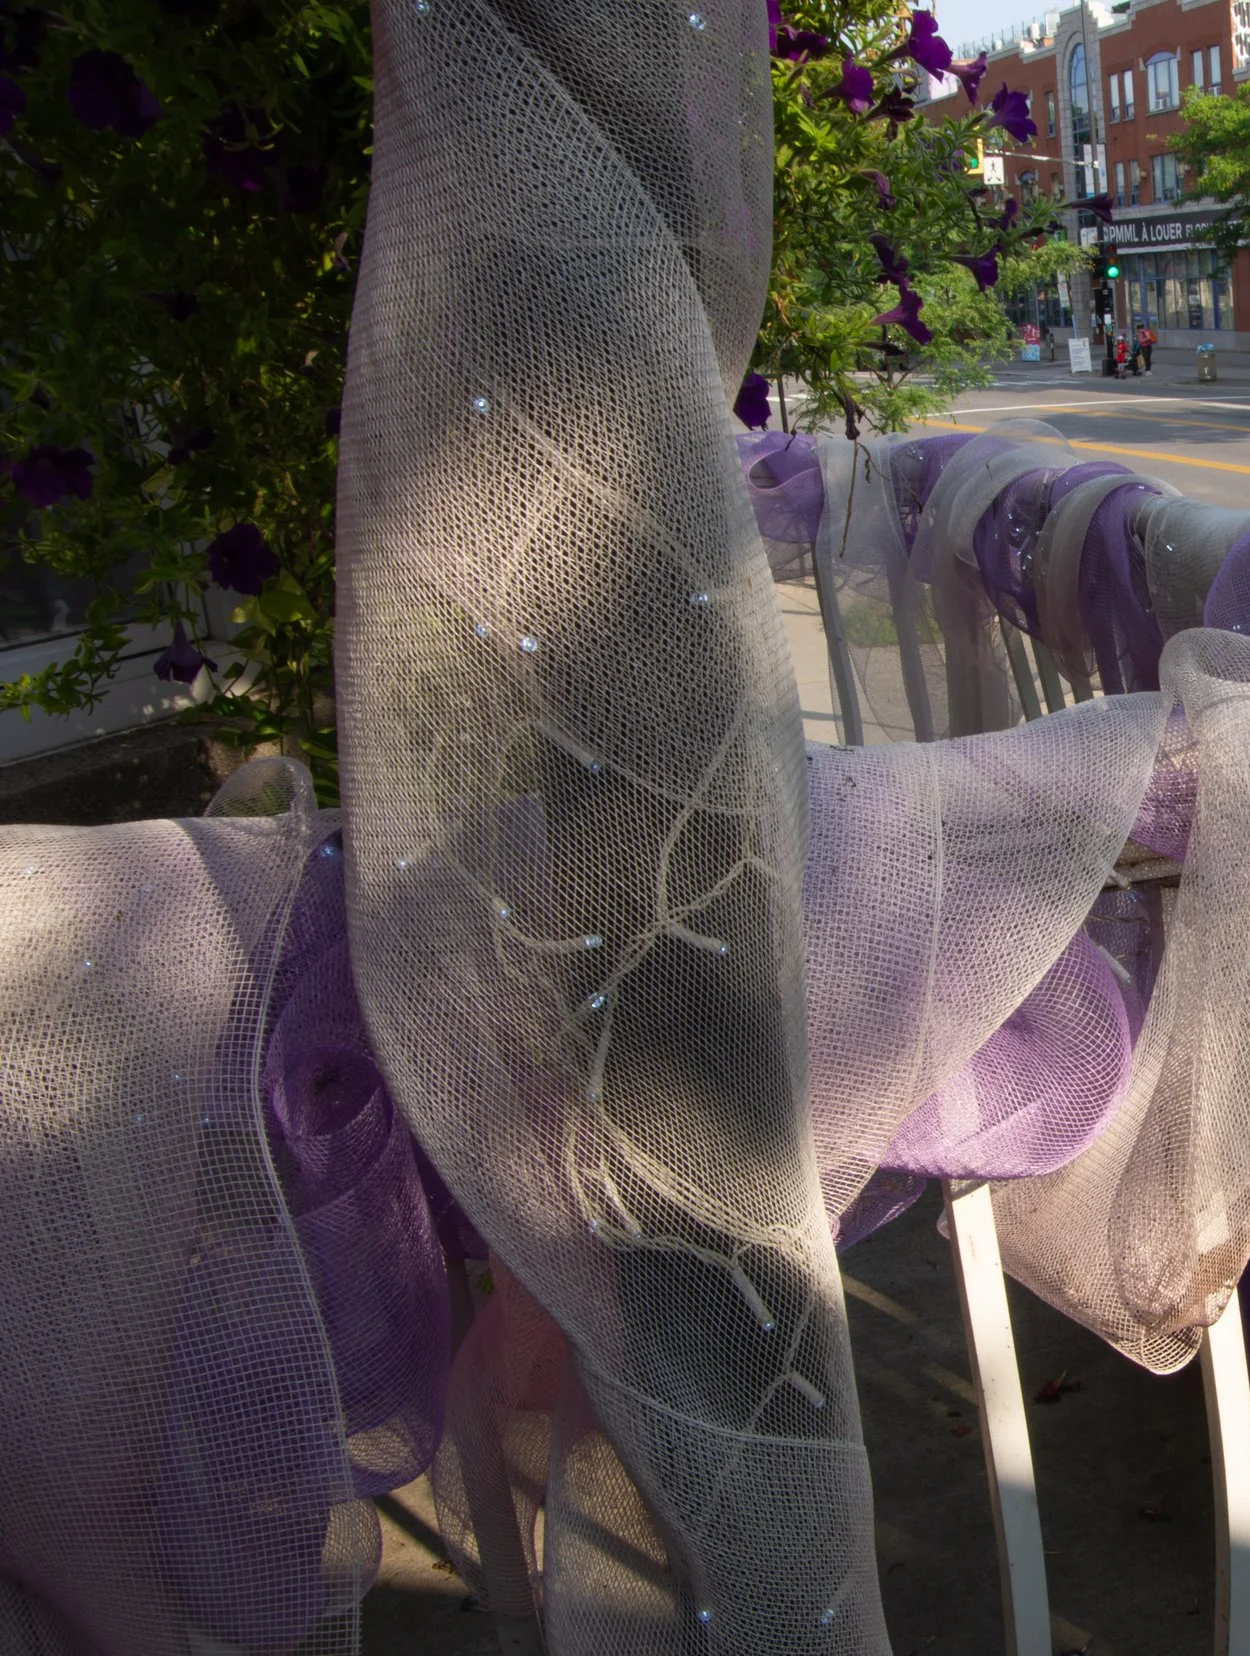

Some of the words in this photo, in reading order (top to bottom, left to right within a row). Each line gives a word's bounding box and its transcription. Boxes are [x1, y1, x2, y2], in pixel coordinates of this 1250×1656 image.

[1110, 224, 1139, 244] PMML
[1142, 222, 1149, 242] À
[1150, 223, 1182, 242] LOUER
